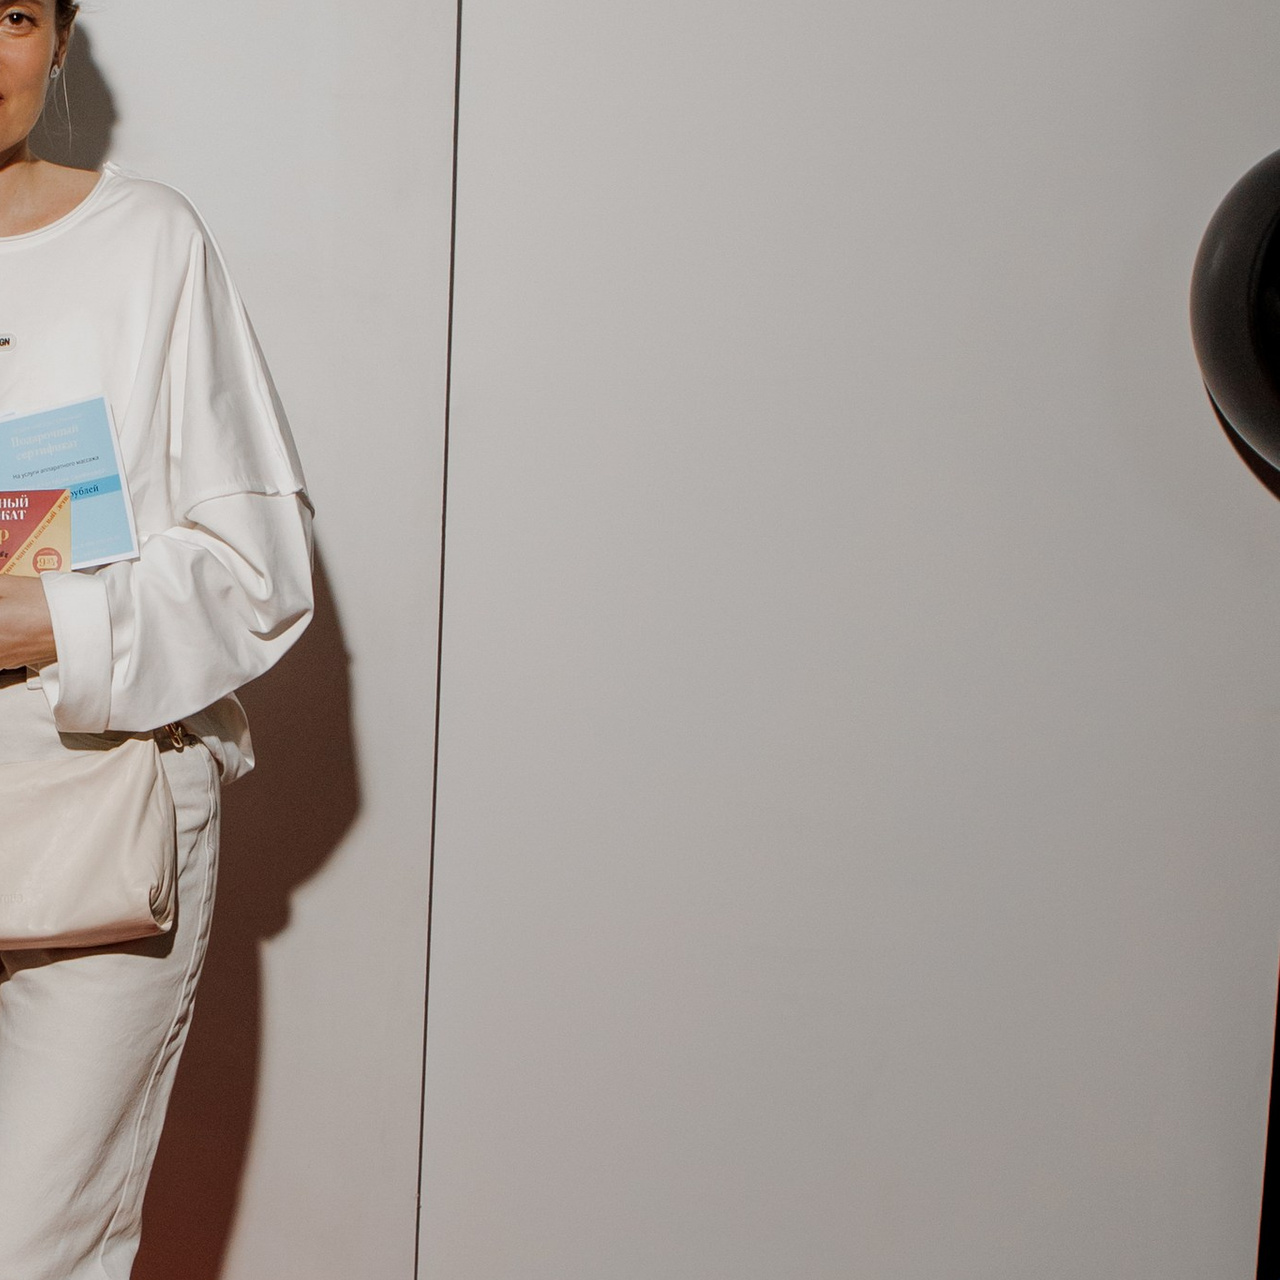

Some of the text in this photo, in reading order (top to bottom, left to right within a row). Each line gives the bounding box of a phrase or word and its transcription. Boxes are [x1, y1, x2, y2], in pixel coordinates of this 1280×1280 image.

[21, 469, 40, 480] услуги
[40, 460, 76, 474] аппаратного
[76, 455, 99, 466] массажа
